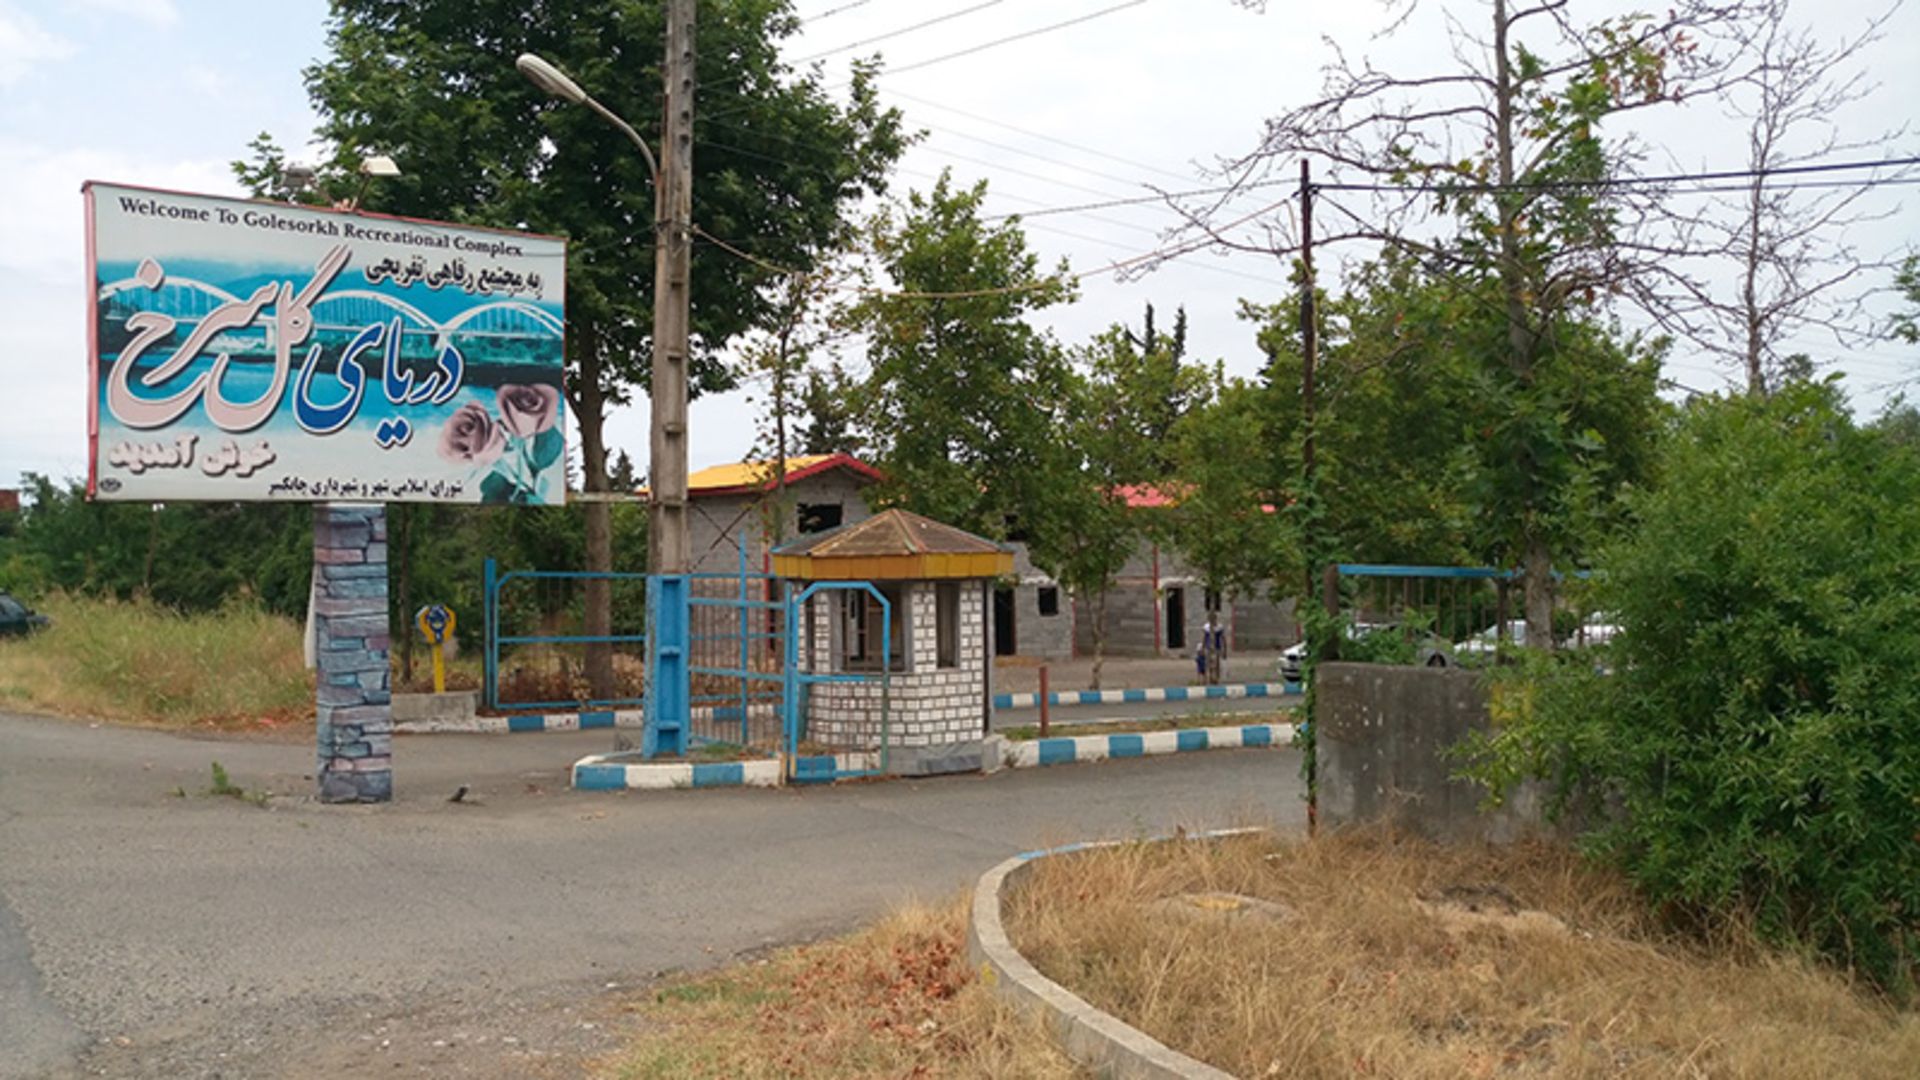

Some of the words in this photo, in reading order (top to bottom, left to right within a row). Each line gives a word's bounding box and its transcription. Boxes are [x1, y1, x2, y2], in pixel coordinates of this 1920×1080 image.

[118, 196, 210, 222] Welcome
[215, 206, 239, 225] To
[243, 211, 339, 236] Golesorkh
[344, 223, 450, 248] Recreational
[452, 236, 524, 258] Complex
[365, 253, 427, 285] تفریحی
[426, 256, 474, 290] رفاهی
[477, 265, 527, 297] مجتمع
[526, 270, 543, 299] به
[106, 257, 280, 429] سرخ
[204, 244, 351, 433] گل
[294, 317, 464, 449] دریای
[109, 434, 199, 474] آمدید
[202, 438, 276, 477] خوش
[311, 477, 358, 497] شهرداری
[361, 481, 369, 497] و
[370, 478, 389, 498] شهر
[391, 477, 428, 498] اسلامی
[430, 479, 463, 498] شورای
